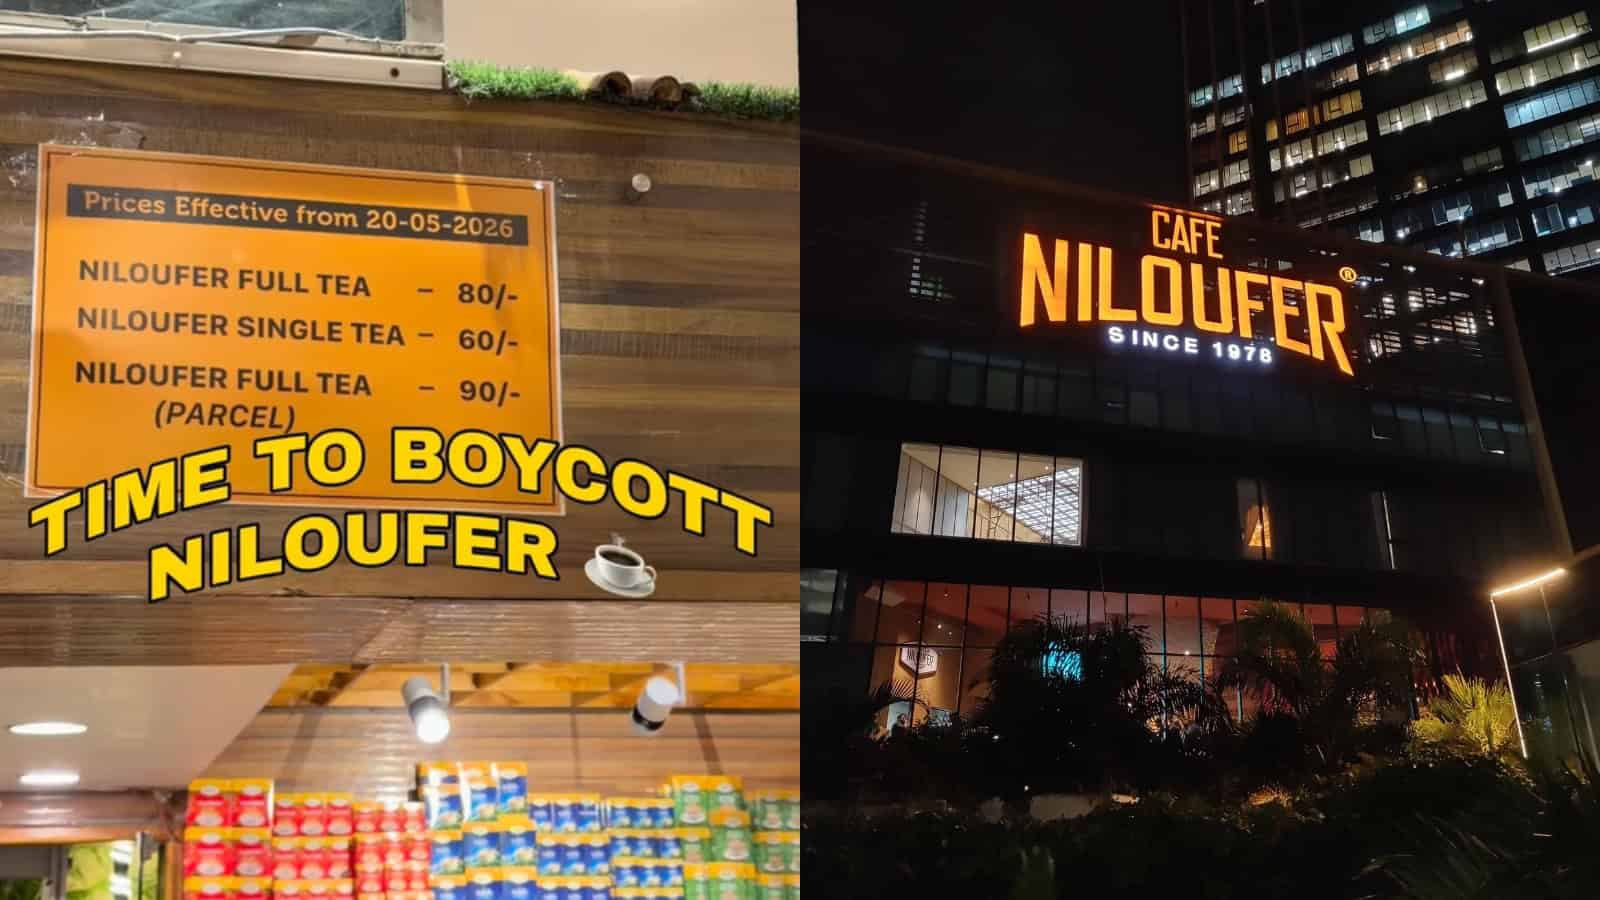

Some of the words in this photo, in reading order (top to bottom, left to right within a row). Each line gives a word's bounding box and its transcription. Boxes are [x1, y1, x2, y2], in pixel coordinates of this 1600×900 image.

[84, 190, 166, 215] Prices
[175, 195, 288, 223] Effective
[296, 205, 358, 229] from
[366, 209, 513, 238] 20-05-2026
[1151, 210, 1224, 260] CAFE
[79, 259, 229, 289] NILOUFER
[238, 269, 309, 293] FULL
[316, 273, 371, 297] TEA
[458, 282, 518, 310] 80/-
[1019, 232, 1355, 377] NILOUFER
[77, 307, 228, 337] NILOUFER
[237, 315, 343, 343] SINGLE
[351, 322, 406, 346] TEA
[458, 329, 519, 356] 60/-
[1108, 326, 1199, 354] SINCE
[1212, 341, 1274, 364] 1978
[75, 361, 228, 389] NILOUFER
[237, 368, 309, 393] FULL
[316, 372, 372, 396] TEA
[460, 379, 521, 408] 90/-
[154, 400, 296, 434] (PARCEL)
